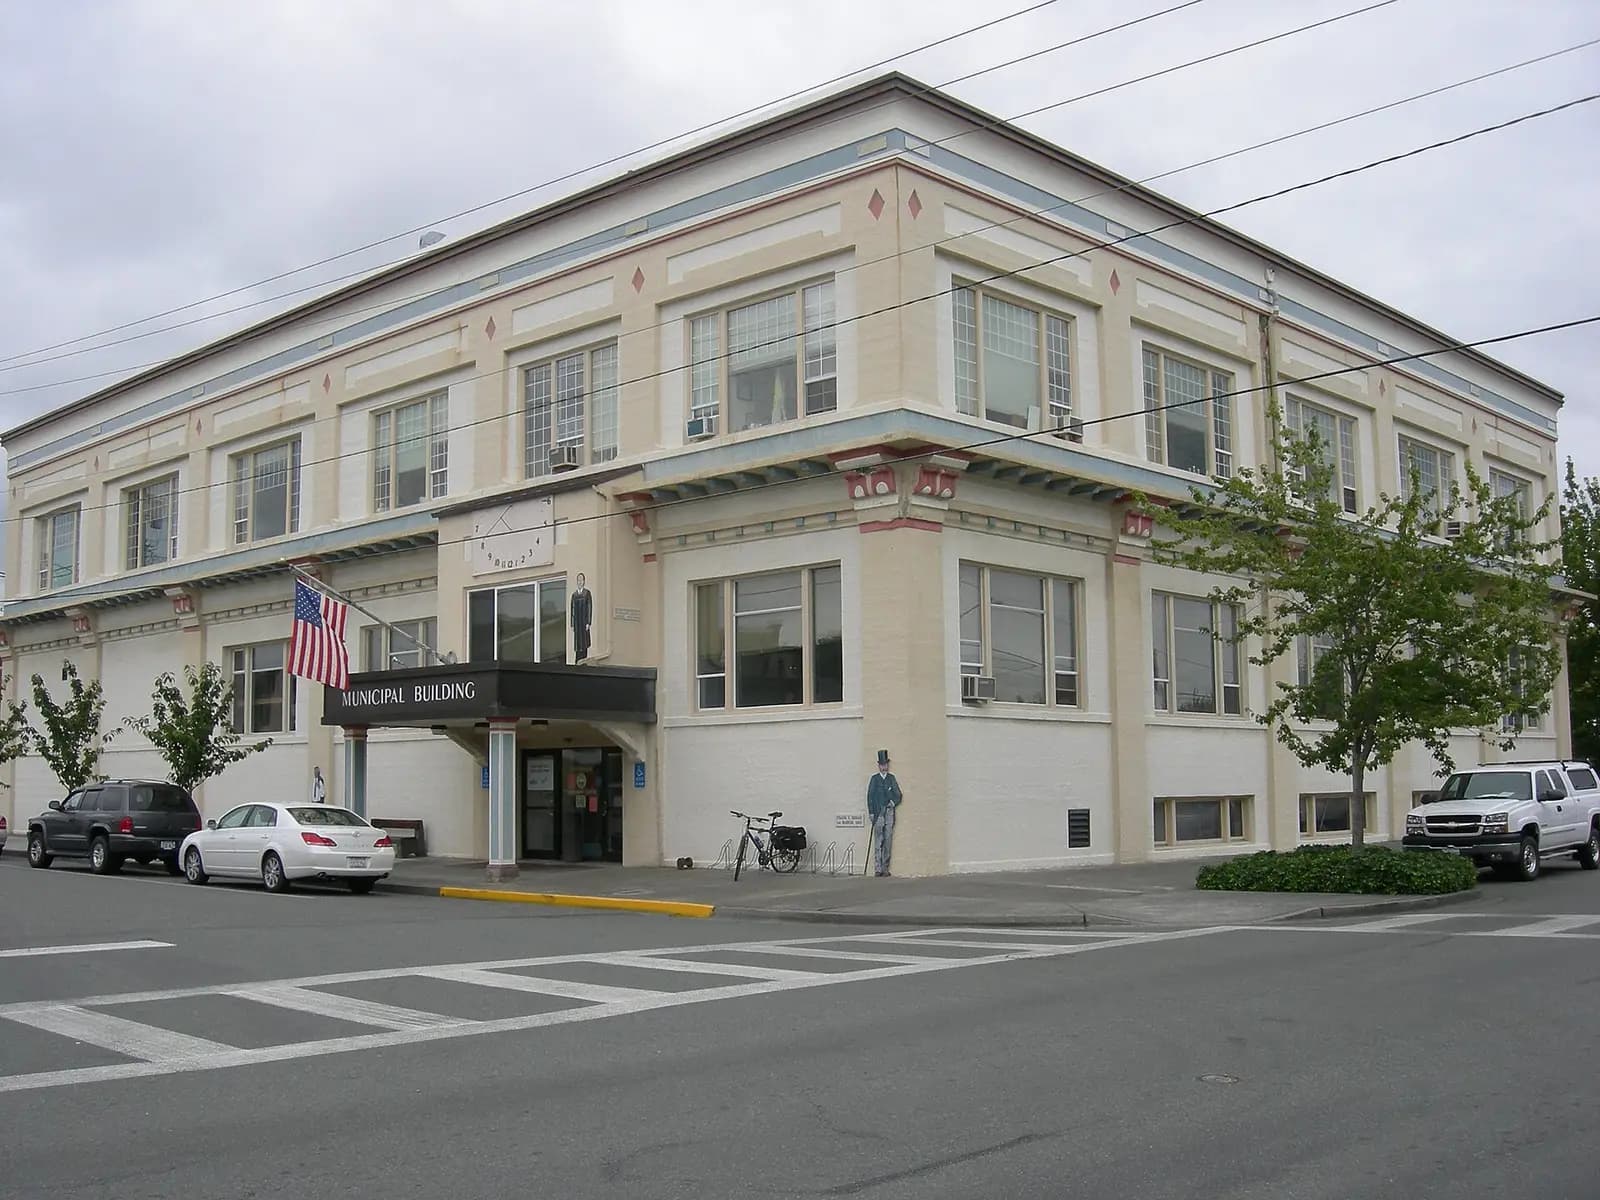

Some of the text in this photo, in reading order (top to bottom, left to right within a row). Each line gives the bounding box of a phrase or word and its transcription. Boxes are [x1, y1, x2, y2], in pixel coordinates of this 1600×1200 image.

[487, 552, 493, 561] 9
[342, 681, 475, 707] MUNICIPAL BUILDING
